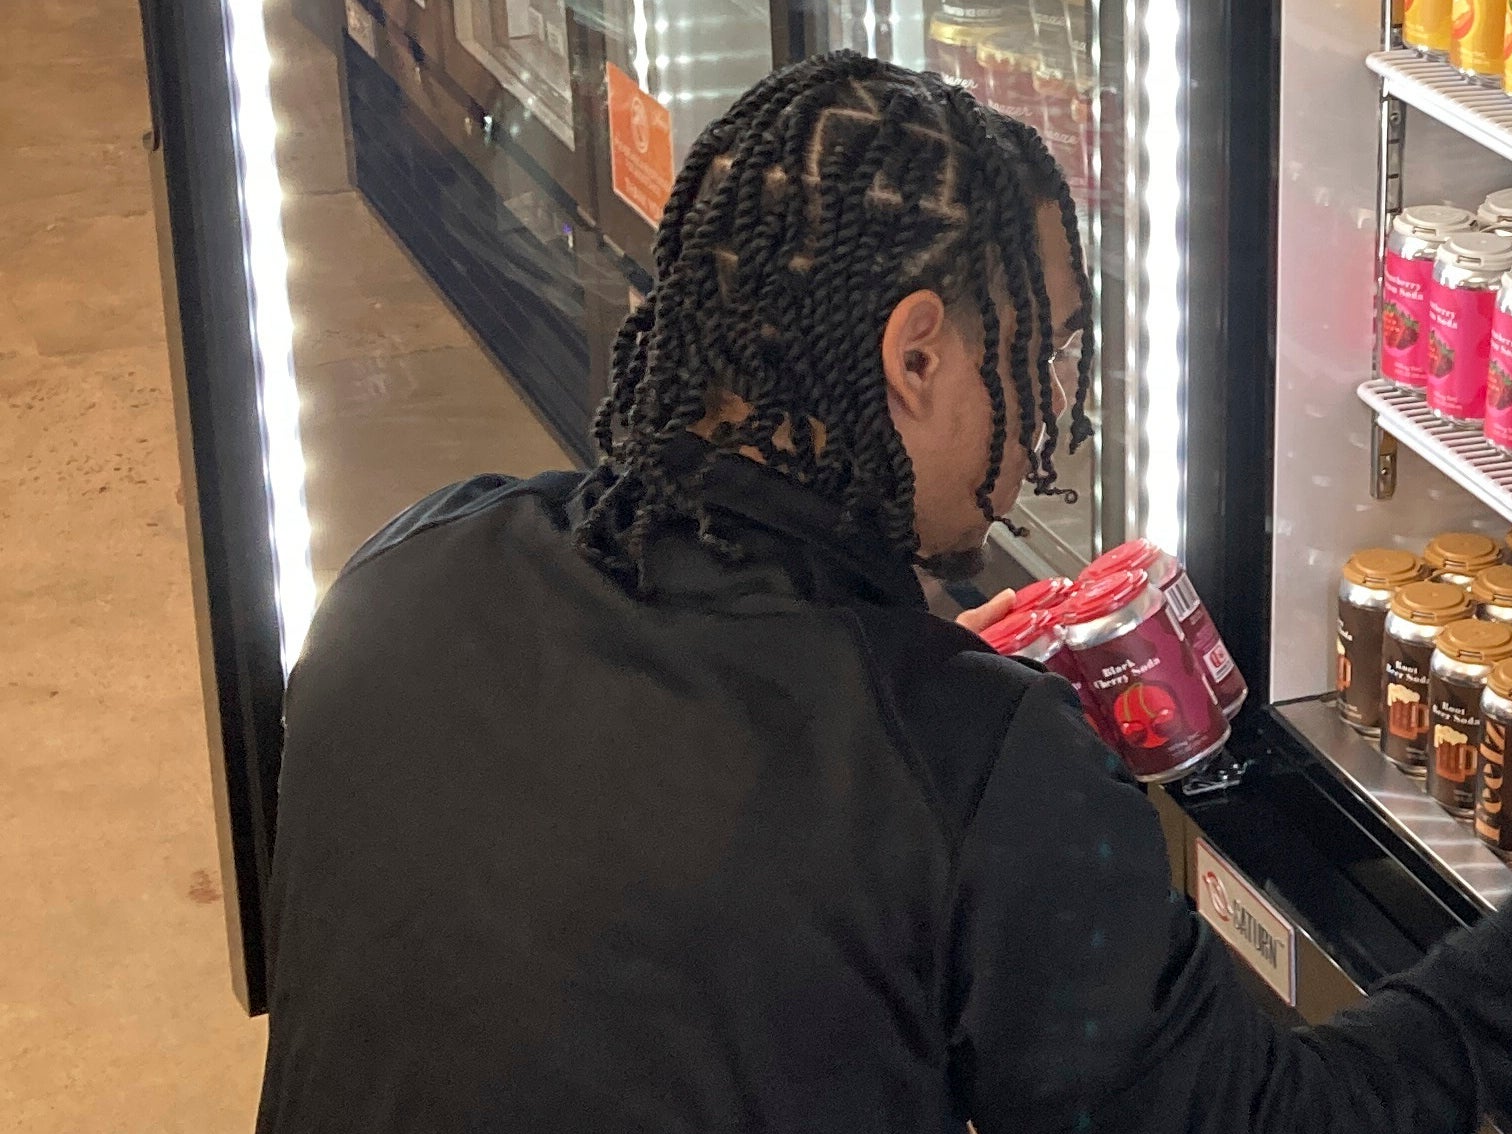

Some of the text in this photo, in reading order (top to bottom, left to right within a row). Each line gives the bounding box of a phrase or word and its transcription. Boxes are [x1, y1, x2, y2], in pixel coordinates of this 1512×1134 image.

[1093, 657, 1161, 690] Cherry Soda
[1102, 659, 1136, 678] Black
[1395, 660, 1418, 675] Root
[1442, 701, 1465, 715] Root
[1452, 713, 1481, 726] Soda
